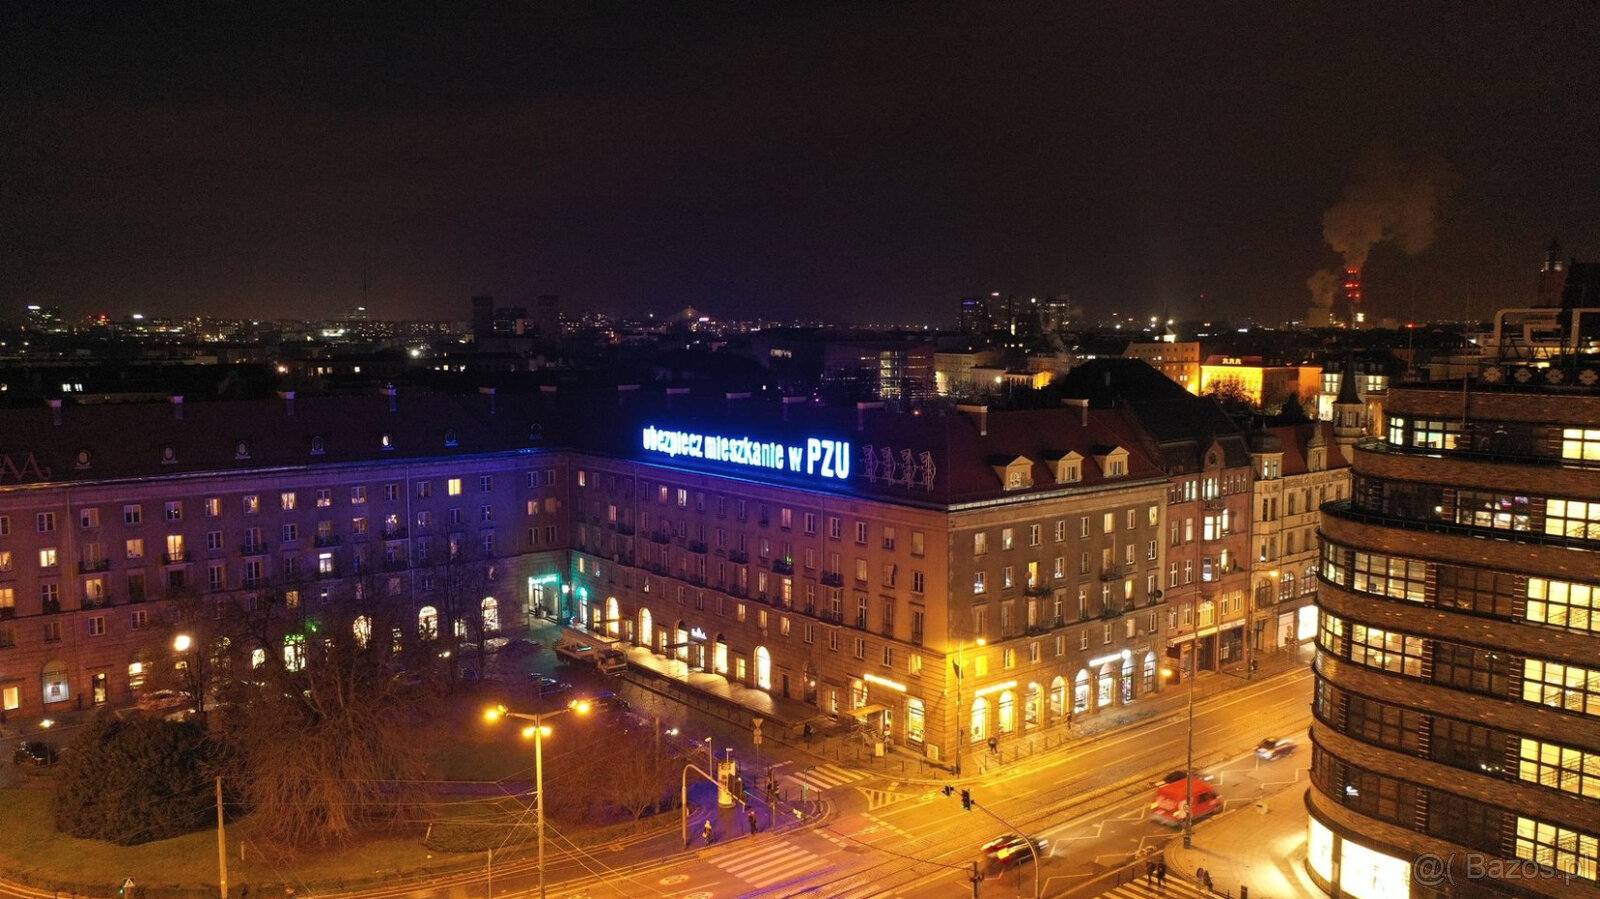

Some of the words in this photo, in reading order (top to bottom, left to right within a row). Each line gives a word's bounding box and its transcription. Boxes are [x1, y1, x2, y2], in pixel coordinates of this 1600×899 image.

[643, 425, 703, 457] ubezpiecz
[705, 436, 784, 469] mieszkanie
[788, 447, 802, 472] w
[807, 438, 849, 479] PZU
